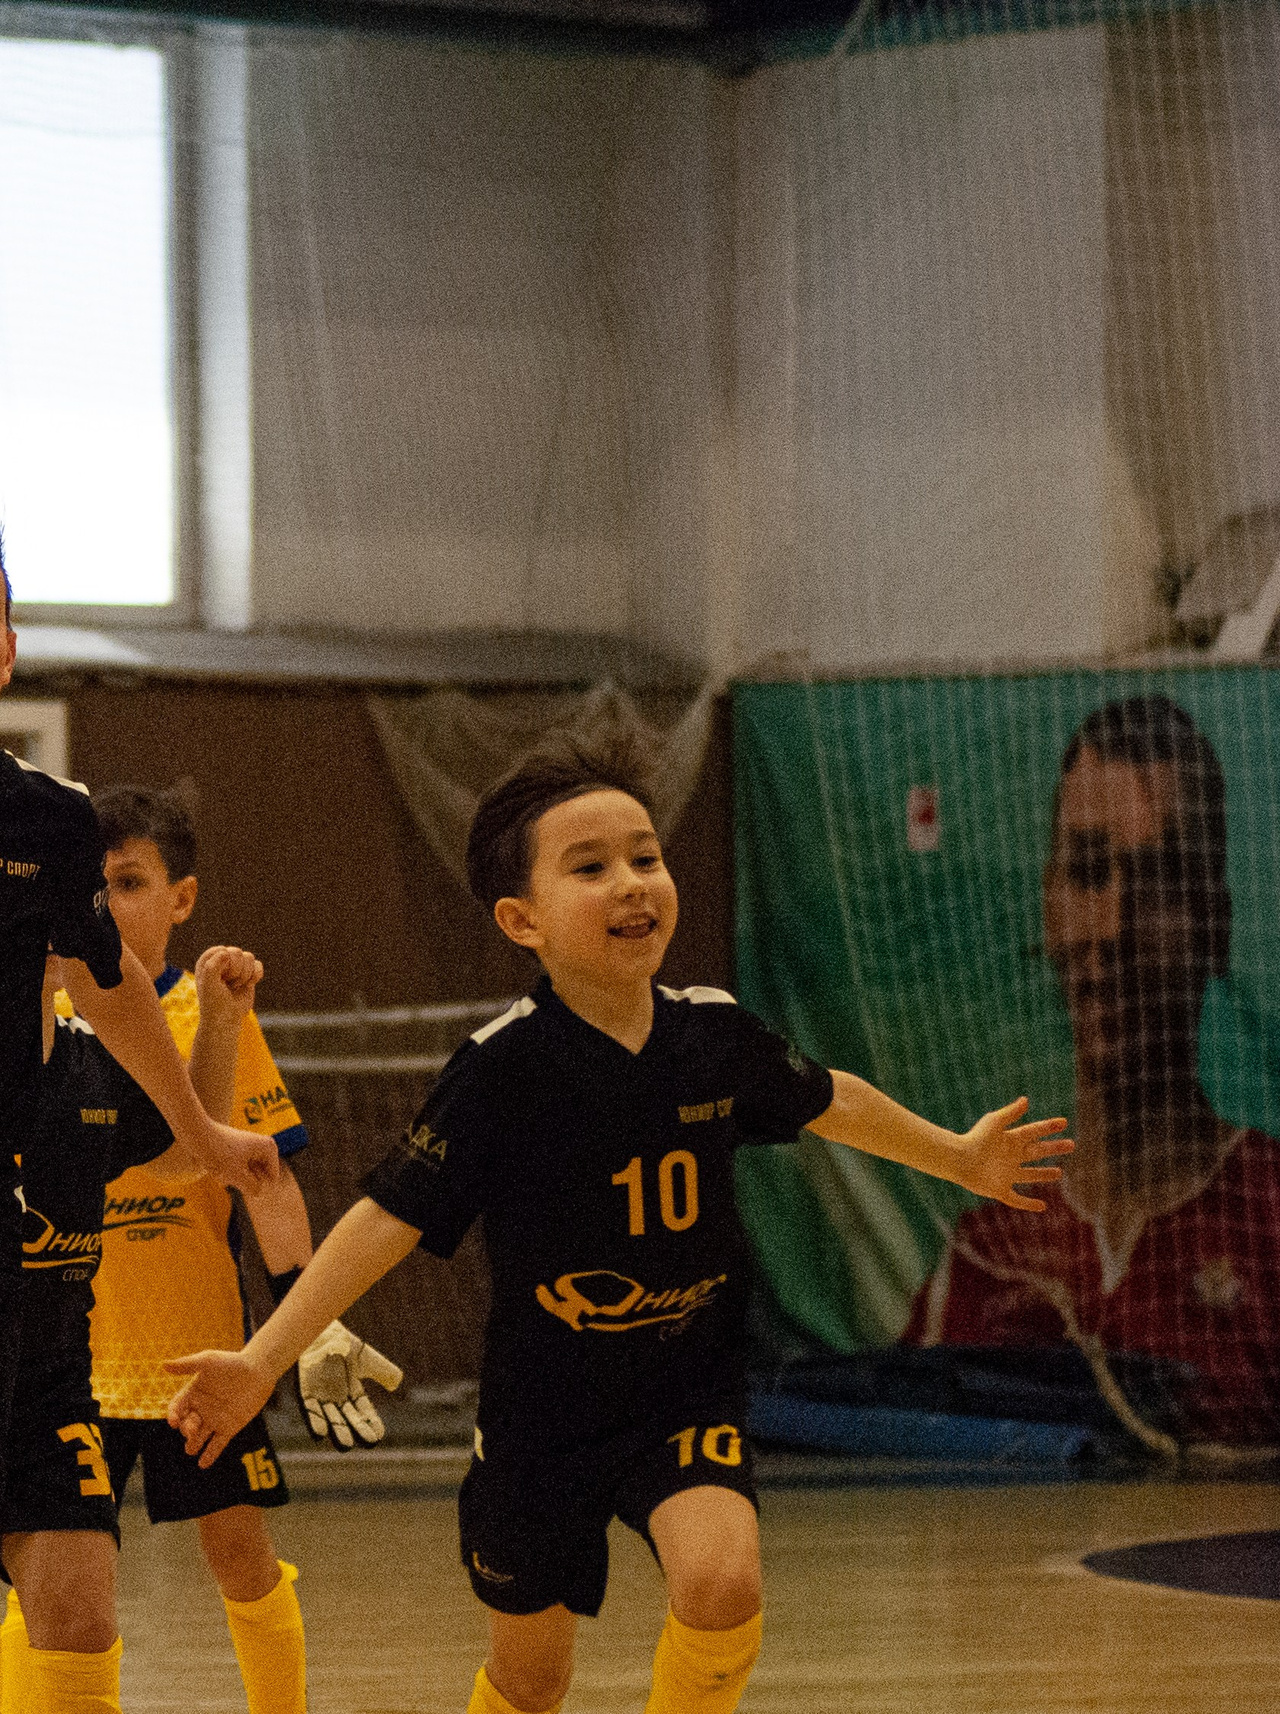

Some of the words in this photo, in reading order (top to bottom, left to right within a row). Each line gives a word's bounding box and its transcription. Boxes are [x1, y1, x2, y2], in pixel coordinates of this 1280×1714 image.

[7, 860, 41, 881] СПОРТ
[104, 1196, 186, 1215] НИОР
[611, 1149, 699, 1236] 10
[56, 1421, 111, 1498] 3
[667, 1424, 742, 1468] 10
[241, 1447, 280, 1492] 15
